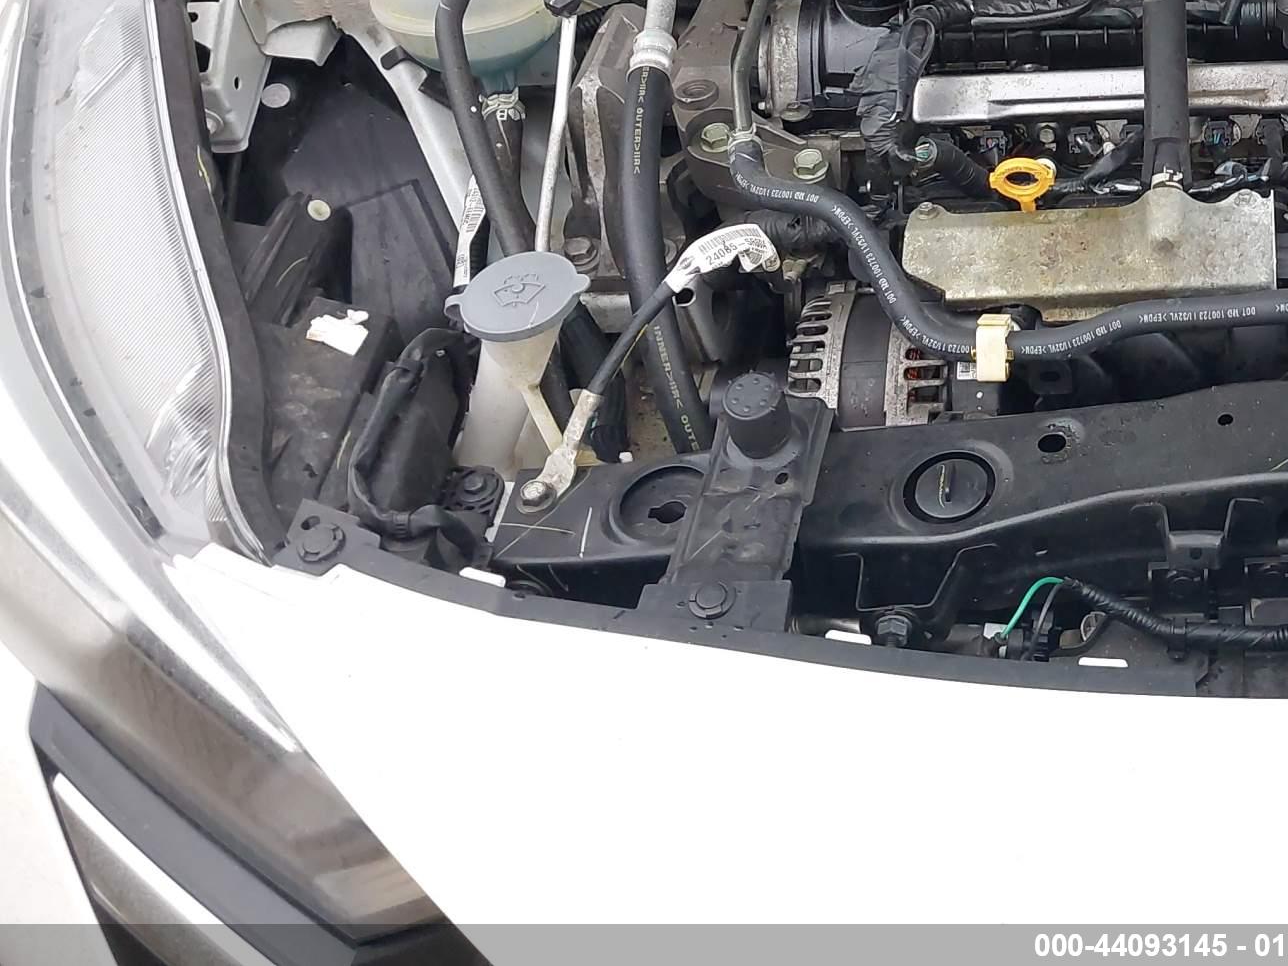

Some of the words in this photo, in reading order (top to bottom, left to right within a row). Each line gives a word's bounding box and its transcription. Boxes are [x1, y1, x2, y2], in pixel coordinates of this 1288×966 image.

[771, 189, 793, 200] 100723
[805, 193, 820, 203] DOT
[865, 252, 883, 278] 100723
[884, 290, 897, 304] DOT
[1199, 309, 1225, 321] 100723
[1242, 306, 1256, 316] DOT
[1108, 320, 1122, 332] DOT
[1072, 330, 1096, 347] 100723
